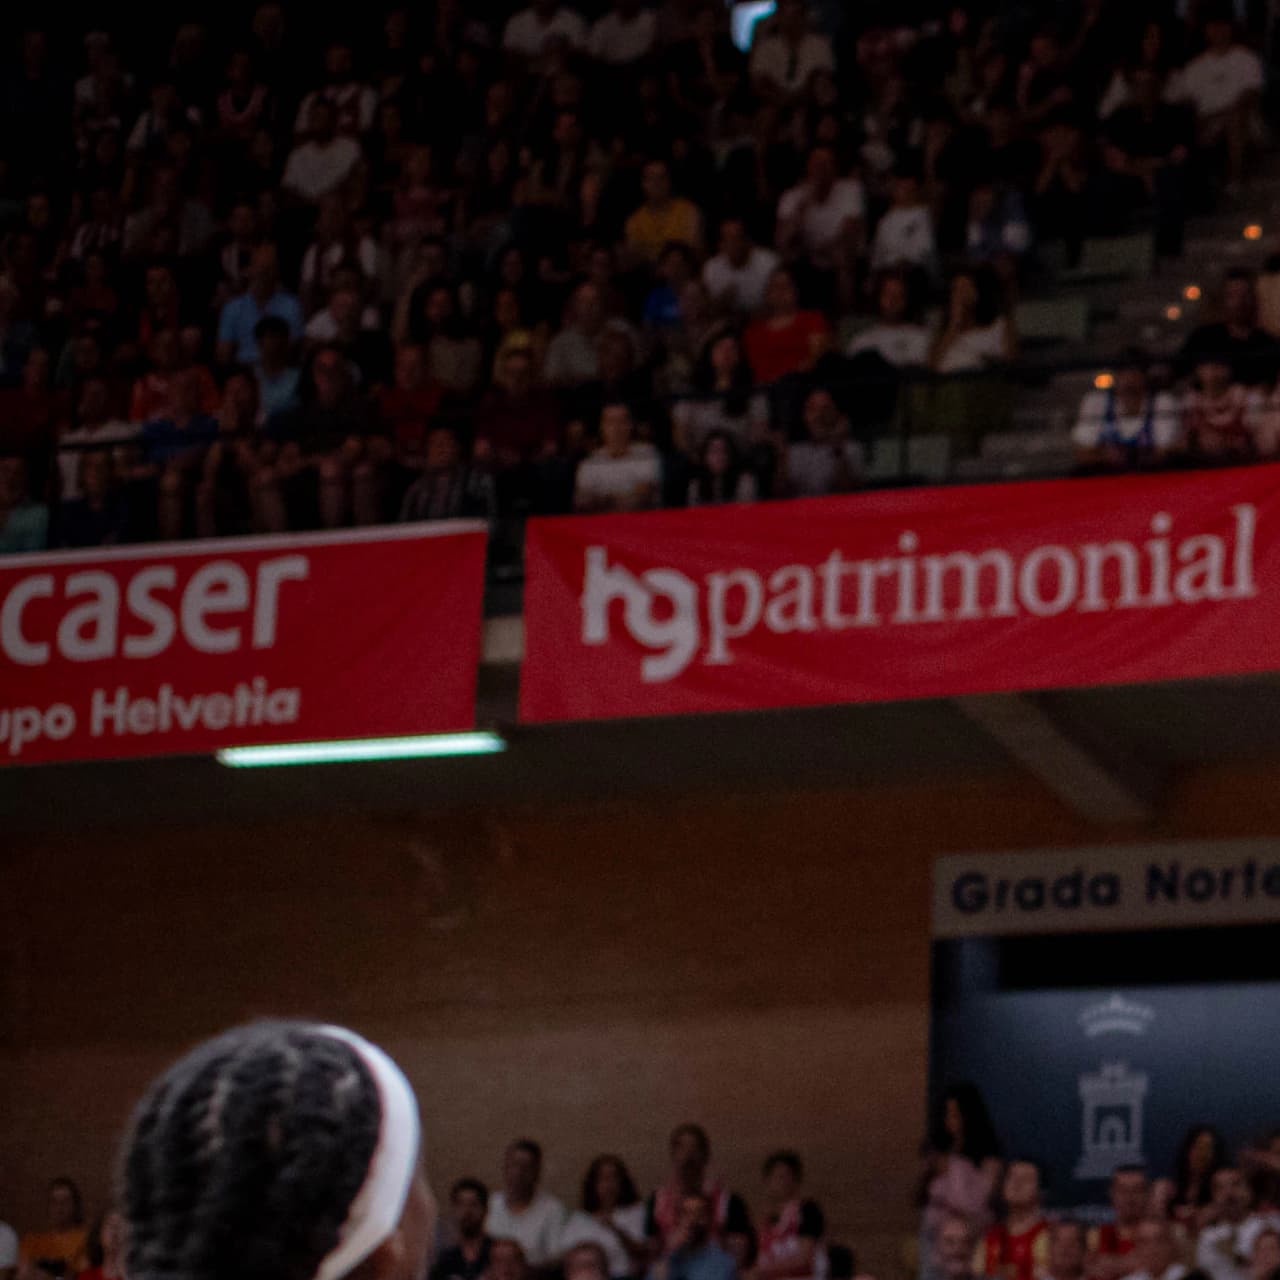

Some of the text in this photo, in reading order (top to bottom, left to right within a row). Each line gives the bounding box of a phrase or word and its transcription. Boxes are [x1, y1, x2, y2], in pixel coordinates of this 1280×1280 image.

[2, 555, 309, 664] caser
[705, 503, 1258, 665] patrimonial
[91, 678, 300, 738] Helvetia
[951, 865, 1121, 913] Grada
